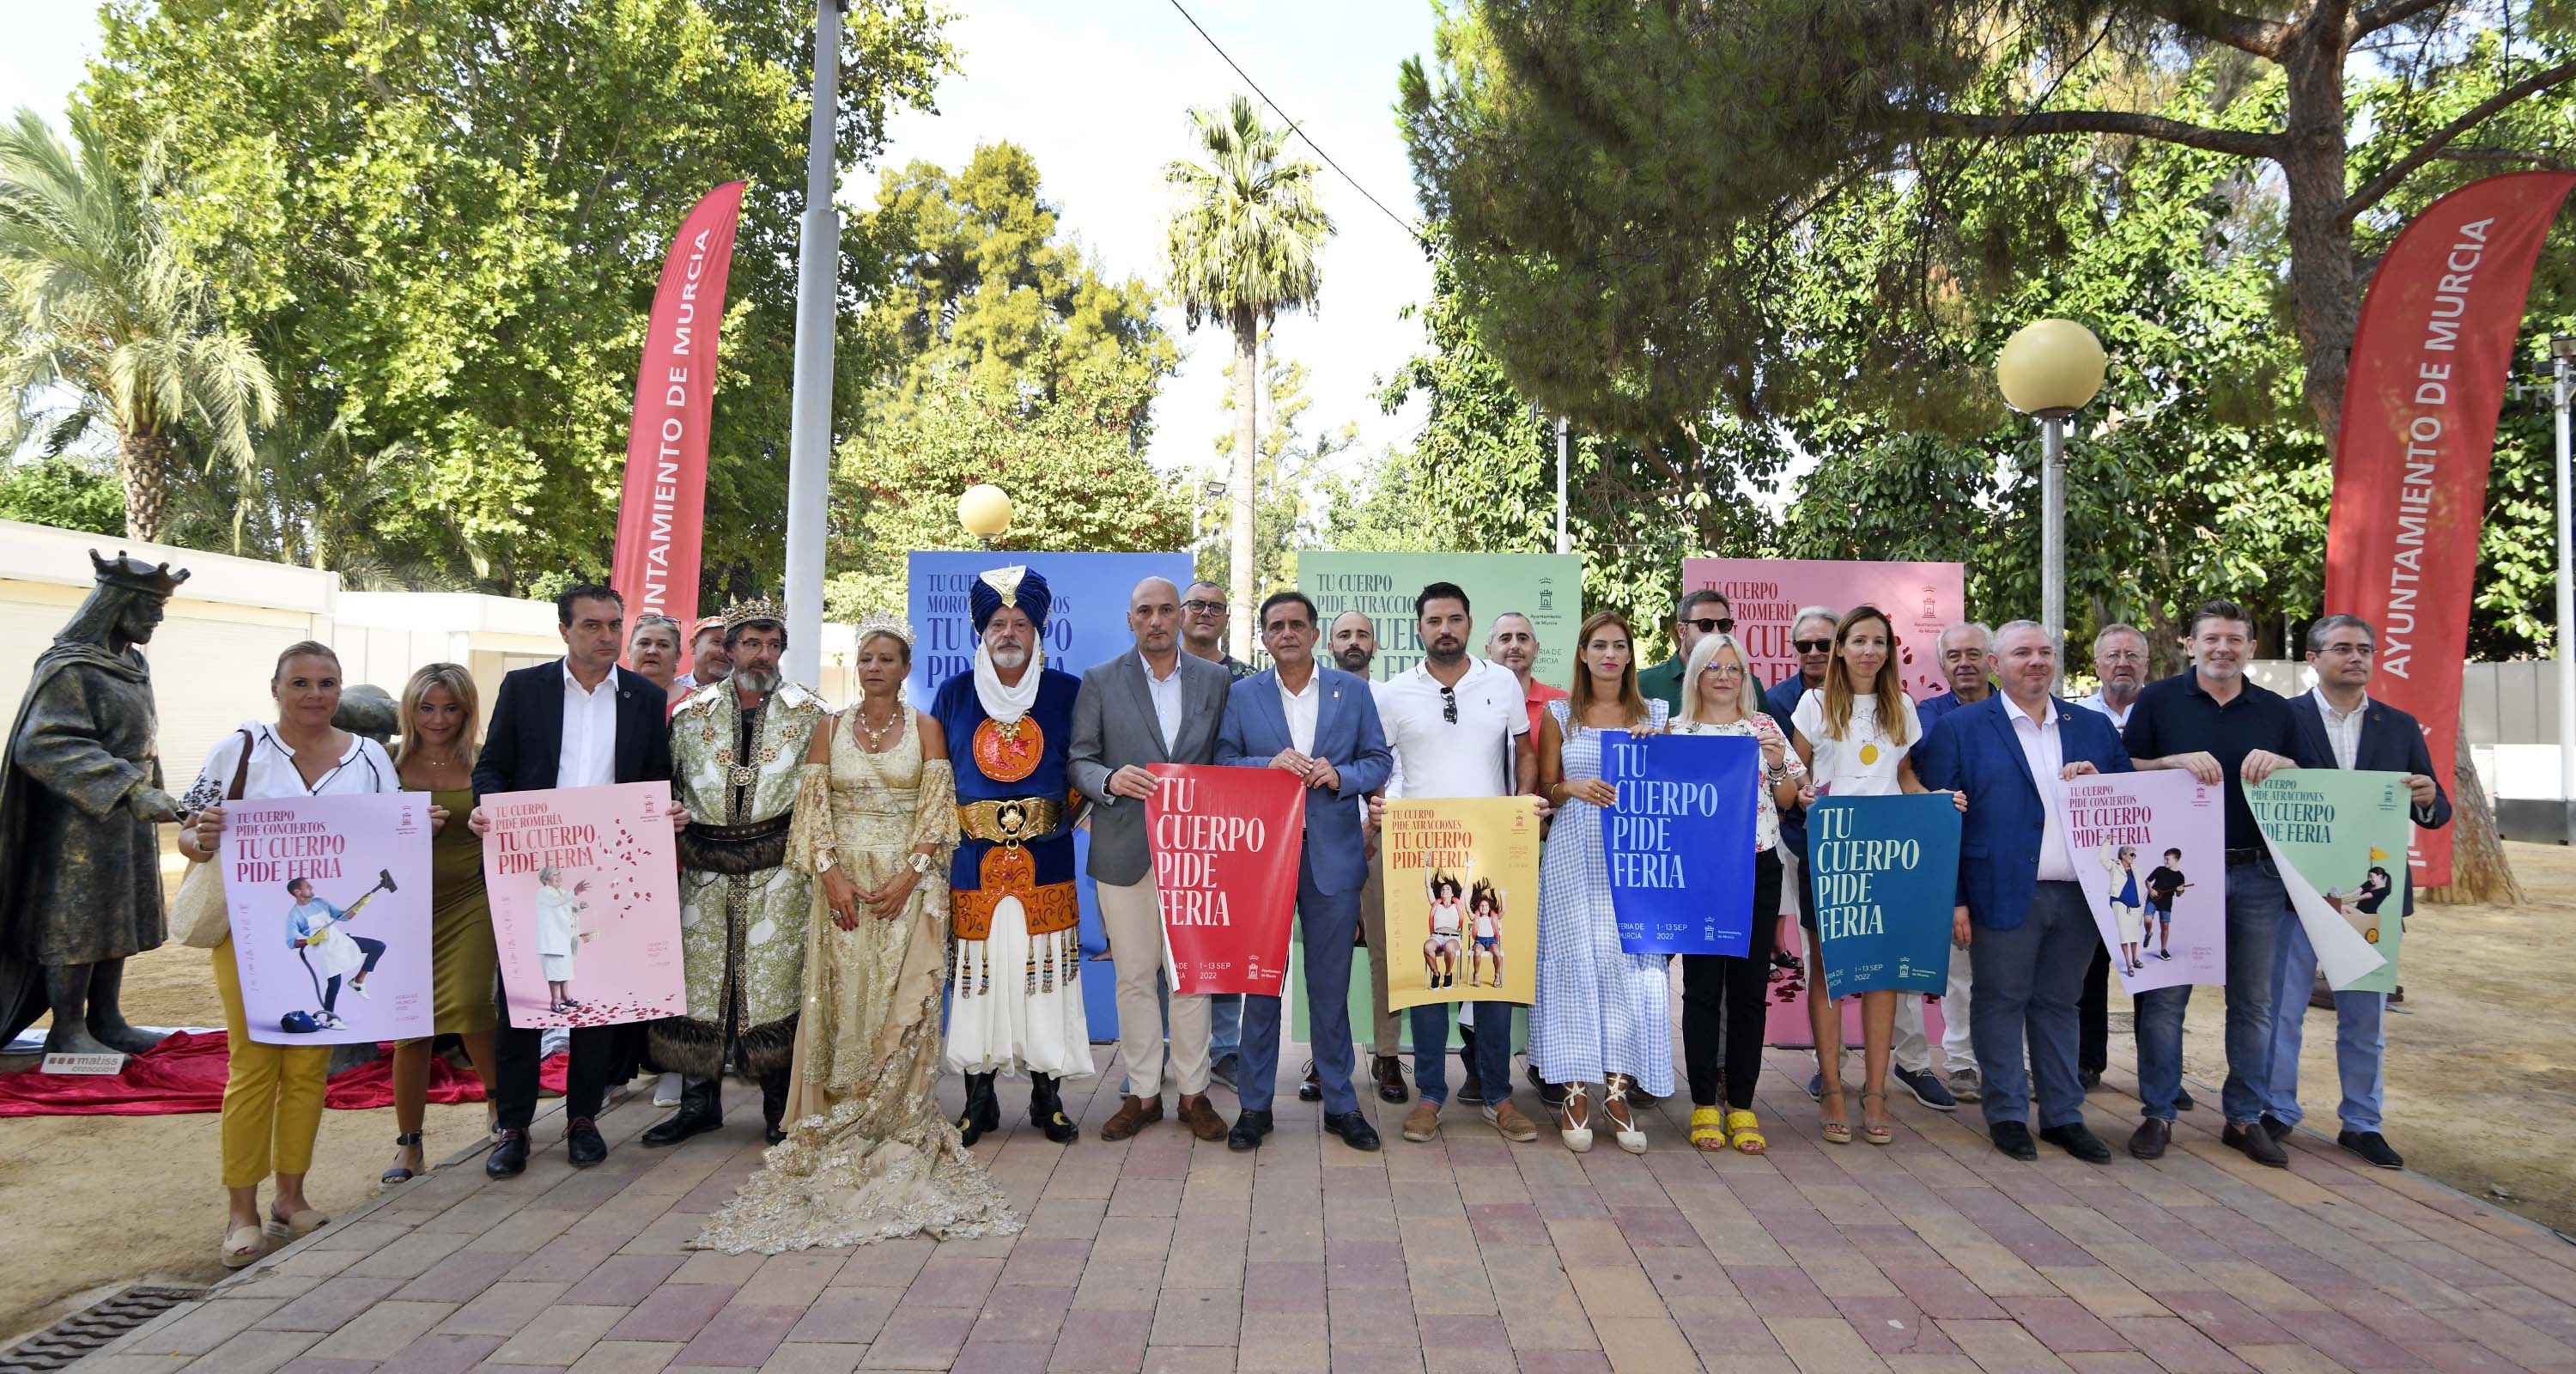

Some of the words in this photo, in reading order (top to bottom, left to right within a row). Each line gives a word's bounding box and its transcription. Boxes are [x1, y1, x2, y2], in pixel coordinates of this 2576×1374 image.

[673, 228, 710, 356] MURCIA
[2425, 217, 2494, 351] MURCIA
[666, 367, 687, 407] DE
[2415, 362, 2451, 404] DE
[642, 417, 683, 617] UNTAMIENTO
[2384, 416, 2441, 678] AYUNTAMIENTO
[927, 574, 946, 592] TU
[1316, 574, 1335, 592] TU
[1340, 575, 1393, 592] CUERPO
[1725, 581, 1778, 599] CUERPO
[927, 595, 970, 612] MORO
[1317, 595, 1348, 612] PIDE
[1352, 595, 1417, 613] ATRACCIO
[927, 617, 962, 650] TU
[927, 655, 975, 688] PID
[1613, 744, 1648, 778] TU
[1158, 776, 1196, 813] TU
[2069, 787, 2080, 797] TU
[2082, 786, 2113, 796] CUERPO
[2251, 790, 2269, 800] PIDE
[2272, 790, 2324, 802] ATRACCIONES
[2265, 779, 2297, 789] CUERPO
[495, 806, 508, 818] TU
[510, 803, 548, 817] CUERPO
[1614, 780, 1718, 817] CUERPO
[2069, 798, 2087, 808] PIDE
[2089, 795, 2137, 807] CONCIERTOS
[237, 812, 252, 824] TU
[253, 811, 295, 823] CUERPO
[495, 818, 517, 830] PIDE
[519, 813, 562, 829] ROMERÍA
[1392, 811, 1403, 819] TU
[1404, 810, 1434, 819] CUERPO
[1392, 821, 1410, 830] PIDE
[1411, 820, 1461, 830] ATRACCIONES
[1819, 807, 1854, 840] TU
[2069, 810, 2090, 828] TU
[2094, 806, 2152, 826] CUERPO
[2252, 802, 2270, 821] TU
[2275, 802, 2335, 823] CUERPO
[236, 824, 260, 836] PIDE
[263, 822, 326, 836] CONCIERTOS
[496, 831, 520, 853] TU
[526, 824, 595, 850] CUERPO
[1157, 814, 1266, 853] CUERPO
[1392, 832, 1412, 849] TU
[1416, 831, 1473, 849] CUERPO
[1613, 816, 1672, 852] PIDE
[2073, 829, 2104, 848] PIDE
[2110, 826, 2151, 846] FERIA
[2287, 824, 2331, 843] FERIA
[236, 838, 263, 860] TU
[269, 834, 345, 859] CUERPO
[1393, 851, 1425, 869] PIDE
[1431, 850, 1469, 868] FERIA
[1817, 839, 1920, 873] CUERPO
[237, 860, 281, 883] PIDE
[288, 858, 343, 880] FERIA
[499, 852, 539, 875] PIDE
[545, 846, 595, 869] FERIA
[1157, 851, 1218, 889] PIDE
[1613, 853, 1686, 889] FERIA
[1818, 872, 1874, 909] PIDE
[1159, 890, 1230, 927] FERIA
[1820, 904, 1884, 943] FERIA
[1854, 973, 1870, 982] 2022
[77, 1055, 118, 1066] matiss
